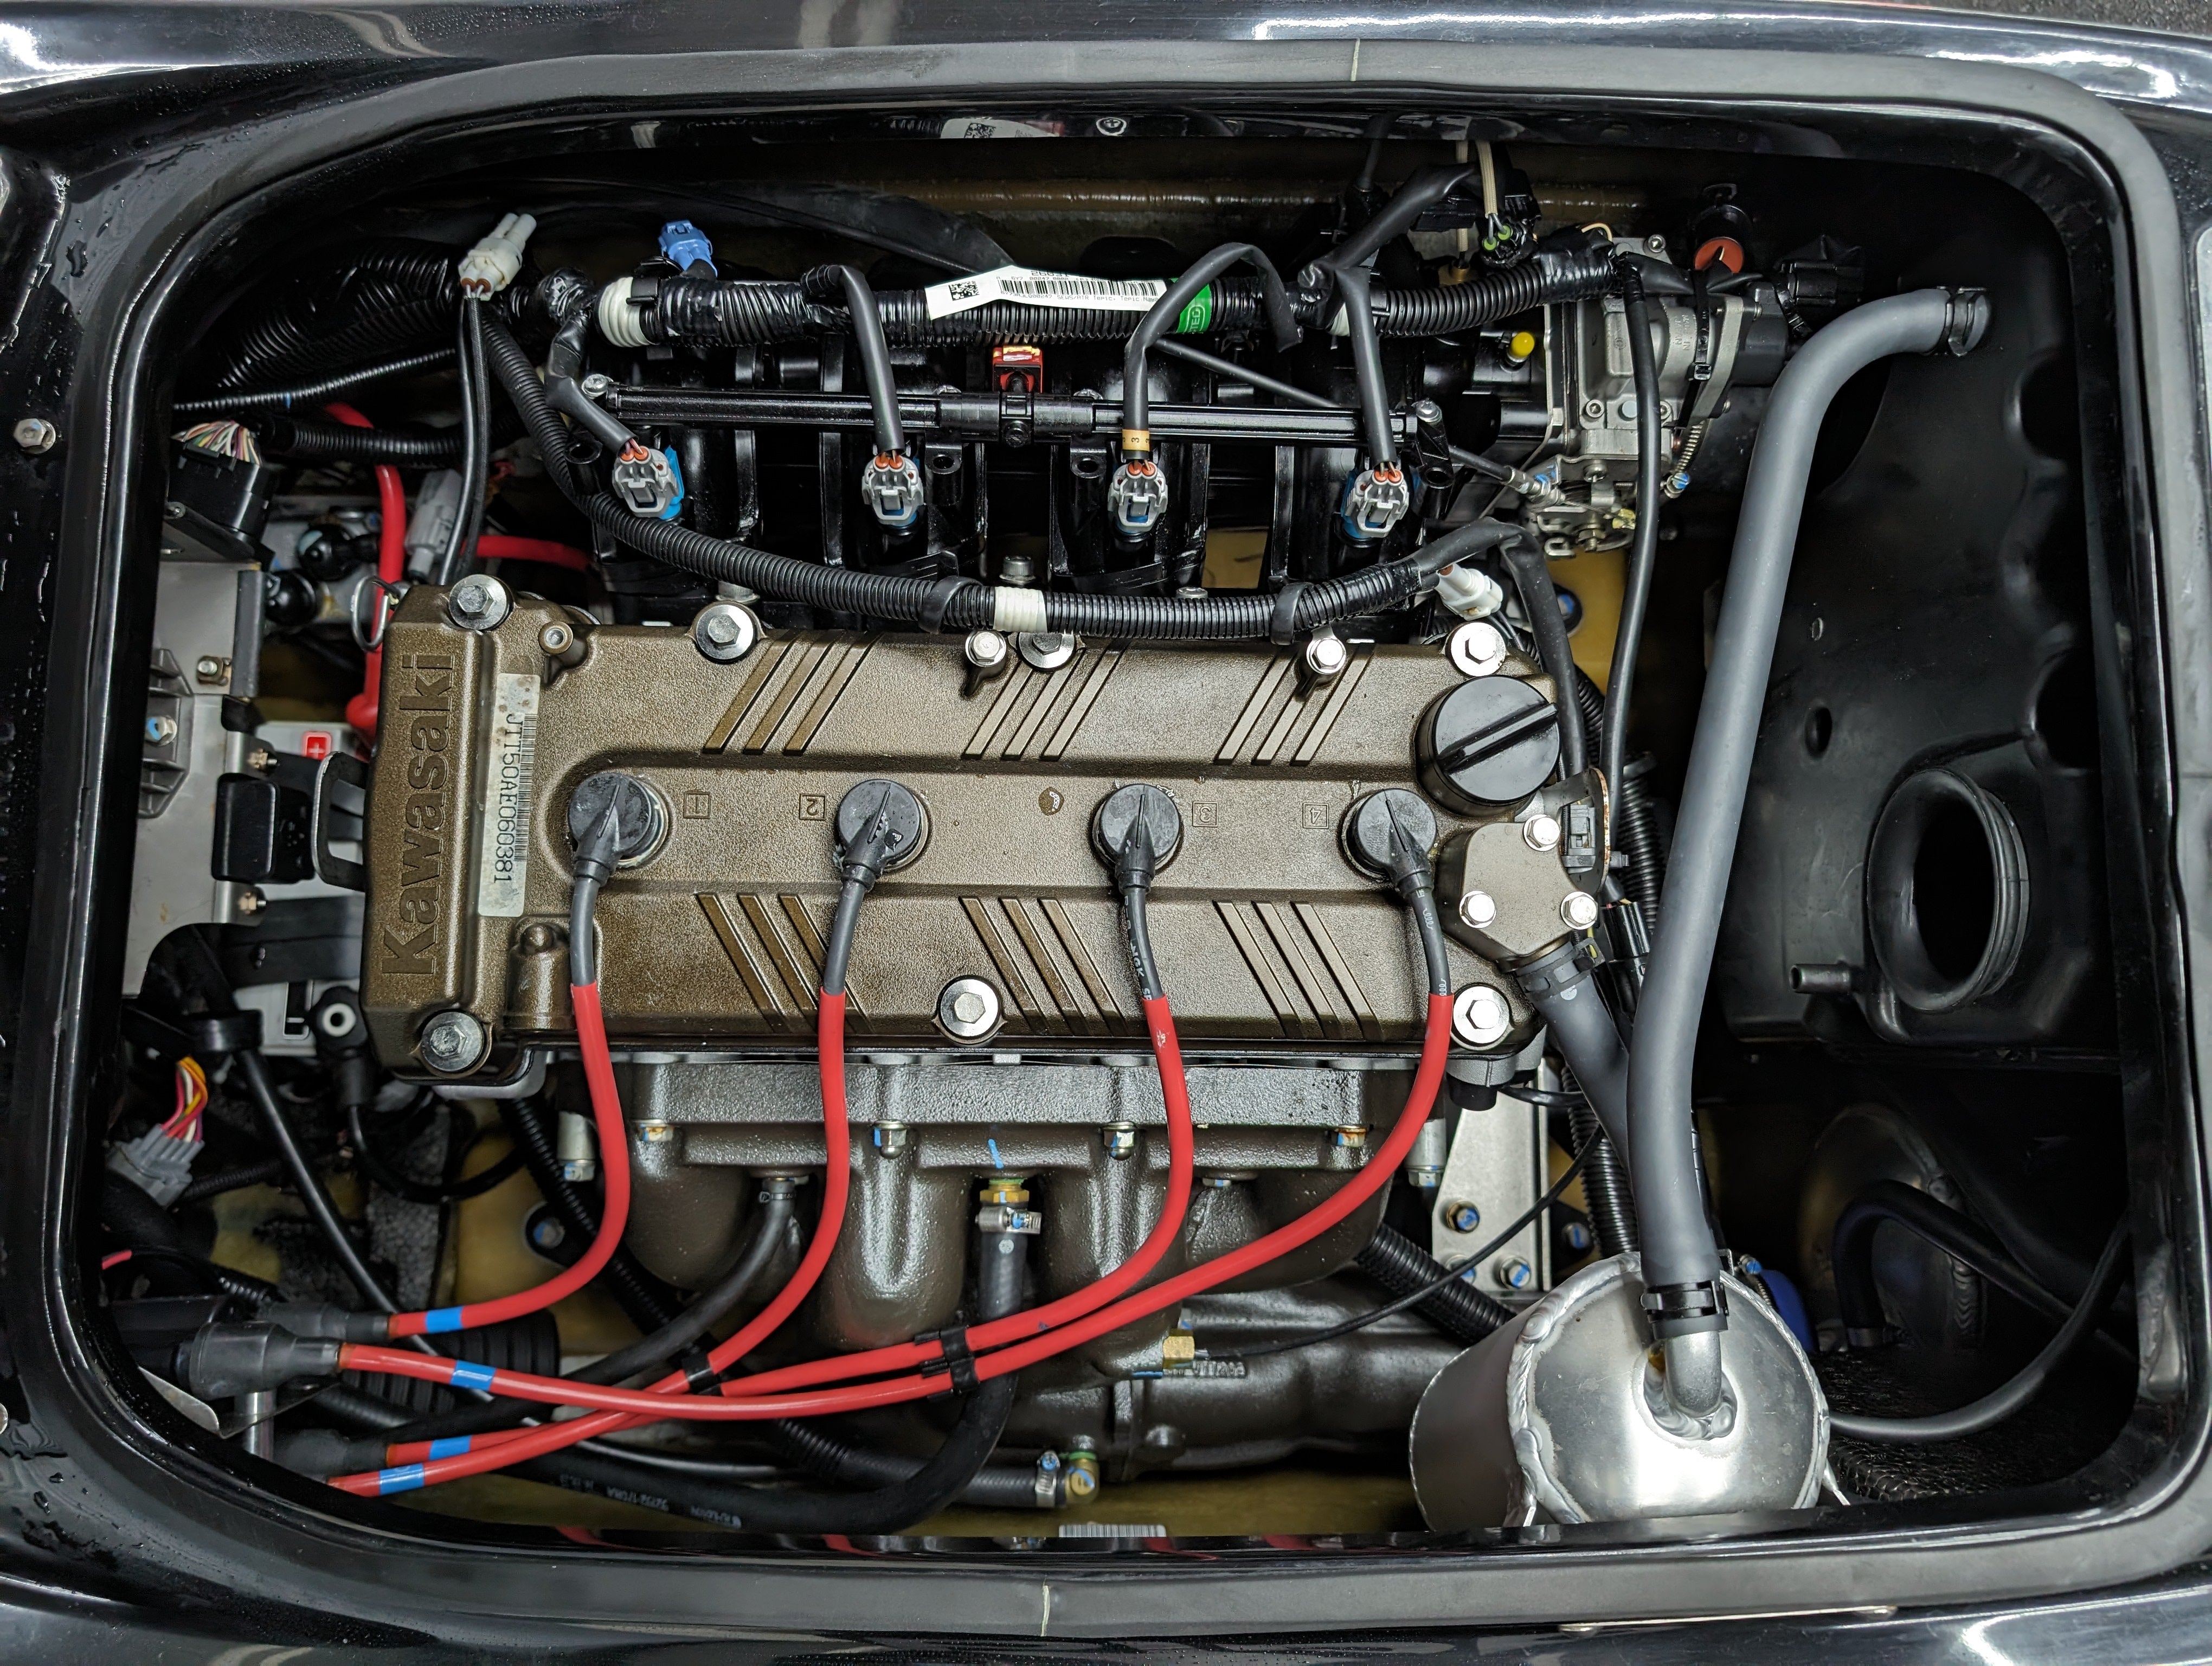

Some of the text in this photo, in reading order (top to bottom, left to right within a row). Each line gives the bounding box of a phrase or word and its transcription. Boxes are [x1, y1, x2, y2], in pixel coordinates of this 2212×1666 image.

[381, 654, 455, 974] Kawasaki
[494, 712, 524, 884] JTT50AE060381
[1130, 945, 1144, 977] NGK
